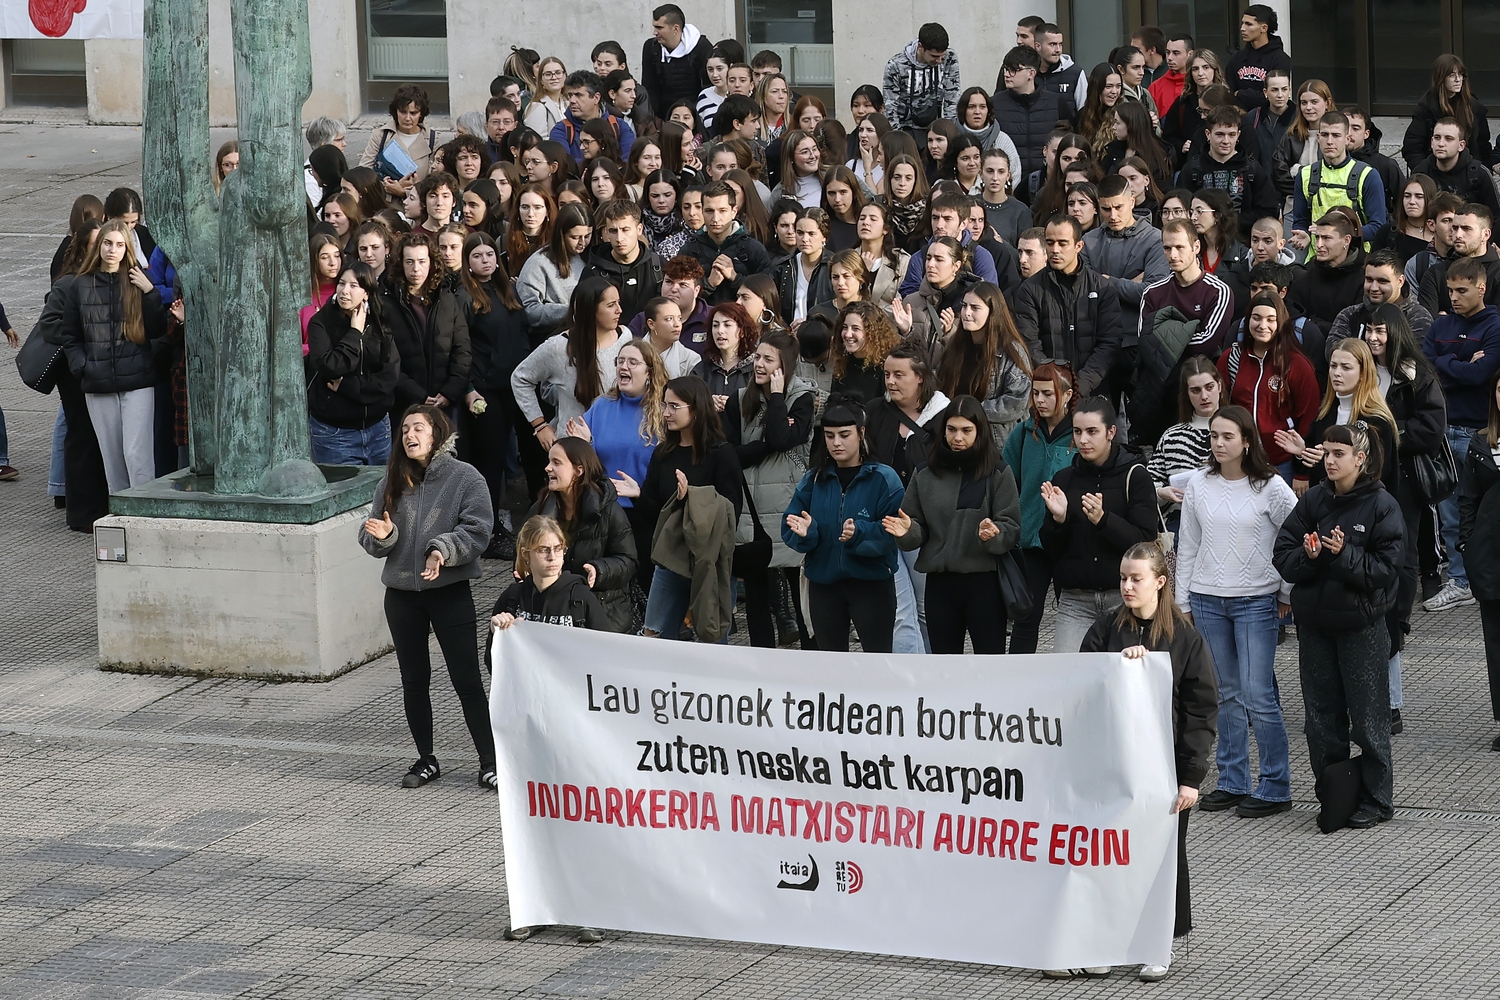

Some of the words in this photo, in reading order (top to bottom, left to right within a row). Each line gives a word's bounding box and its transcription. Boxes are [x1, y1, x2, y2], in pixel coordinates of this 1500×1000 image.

[586, 673, 640, 715] Lau
[650, 687, 774, 725] gizonek
[782, 691, 905, 738] taldean
[917, 696, 1063, 748] bortxatu
[636, 734, 730, 776] zuten
[736, 746, 832, 786] neska
[840, 750, 899, 791] bat
[903, 753, 1025, 805] karpan
[527, 780, 721, 833] INDARKERIA
[729, 794, 925, 850] MATXISTARI
[933, 812, 1039, 863] AURRE
[1048, 823, 1131, 867] EGIN
[779, 860, 809, 877] itaia
